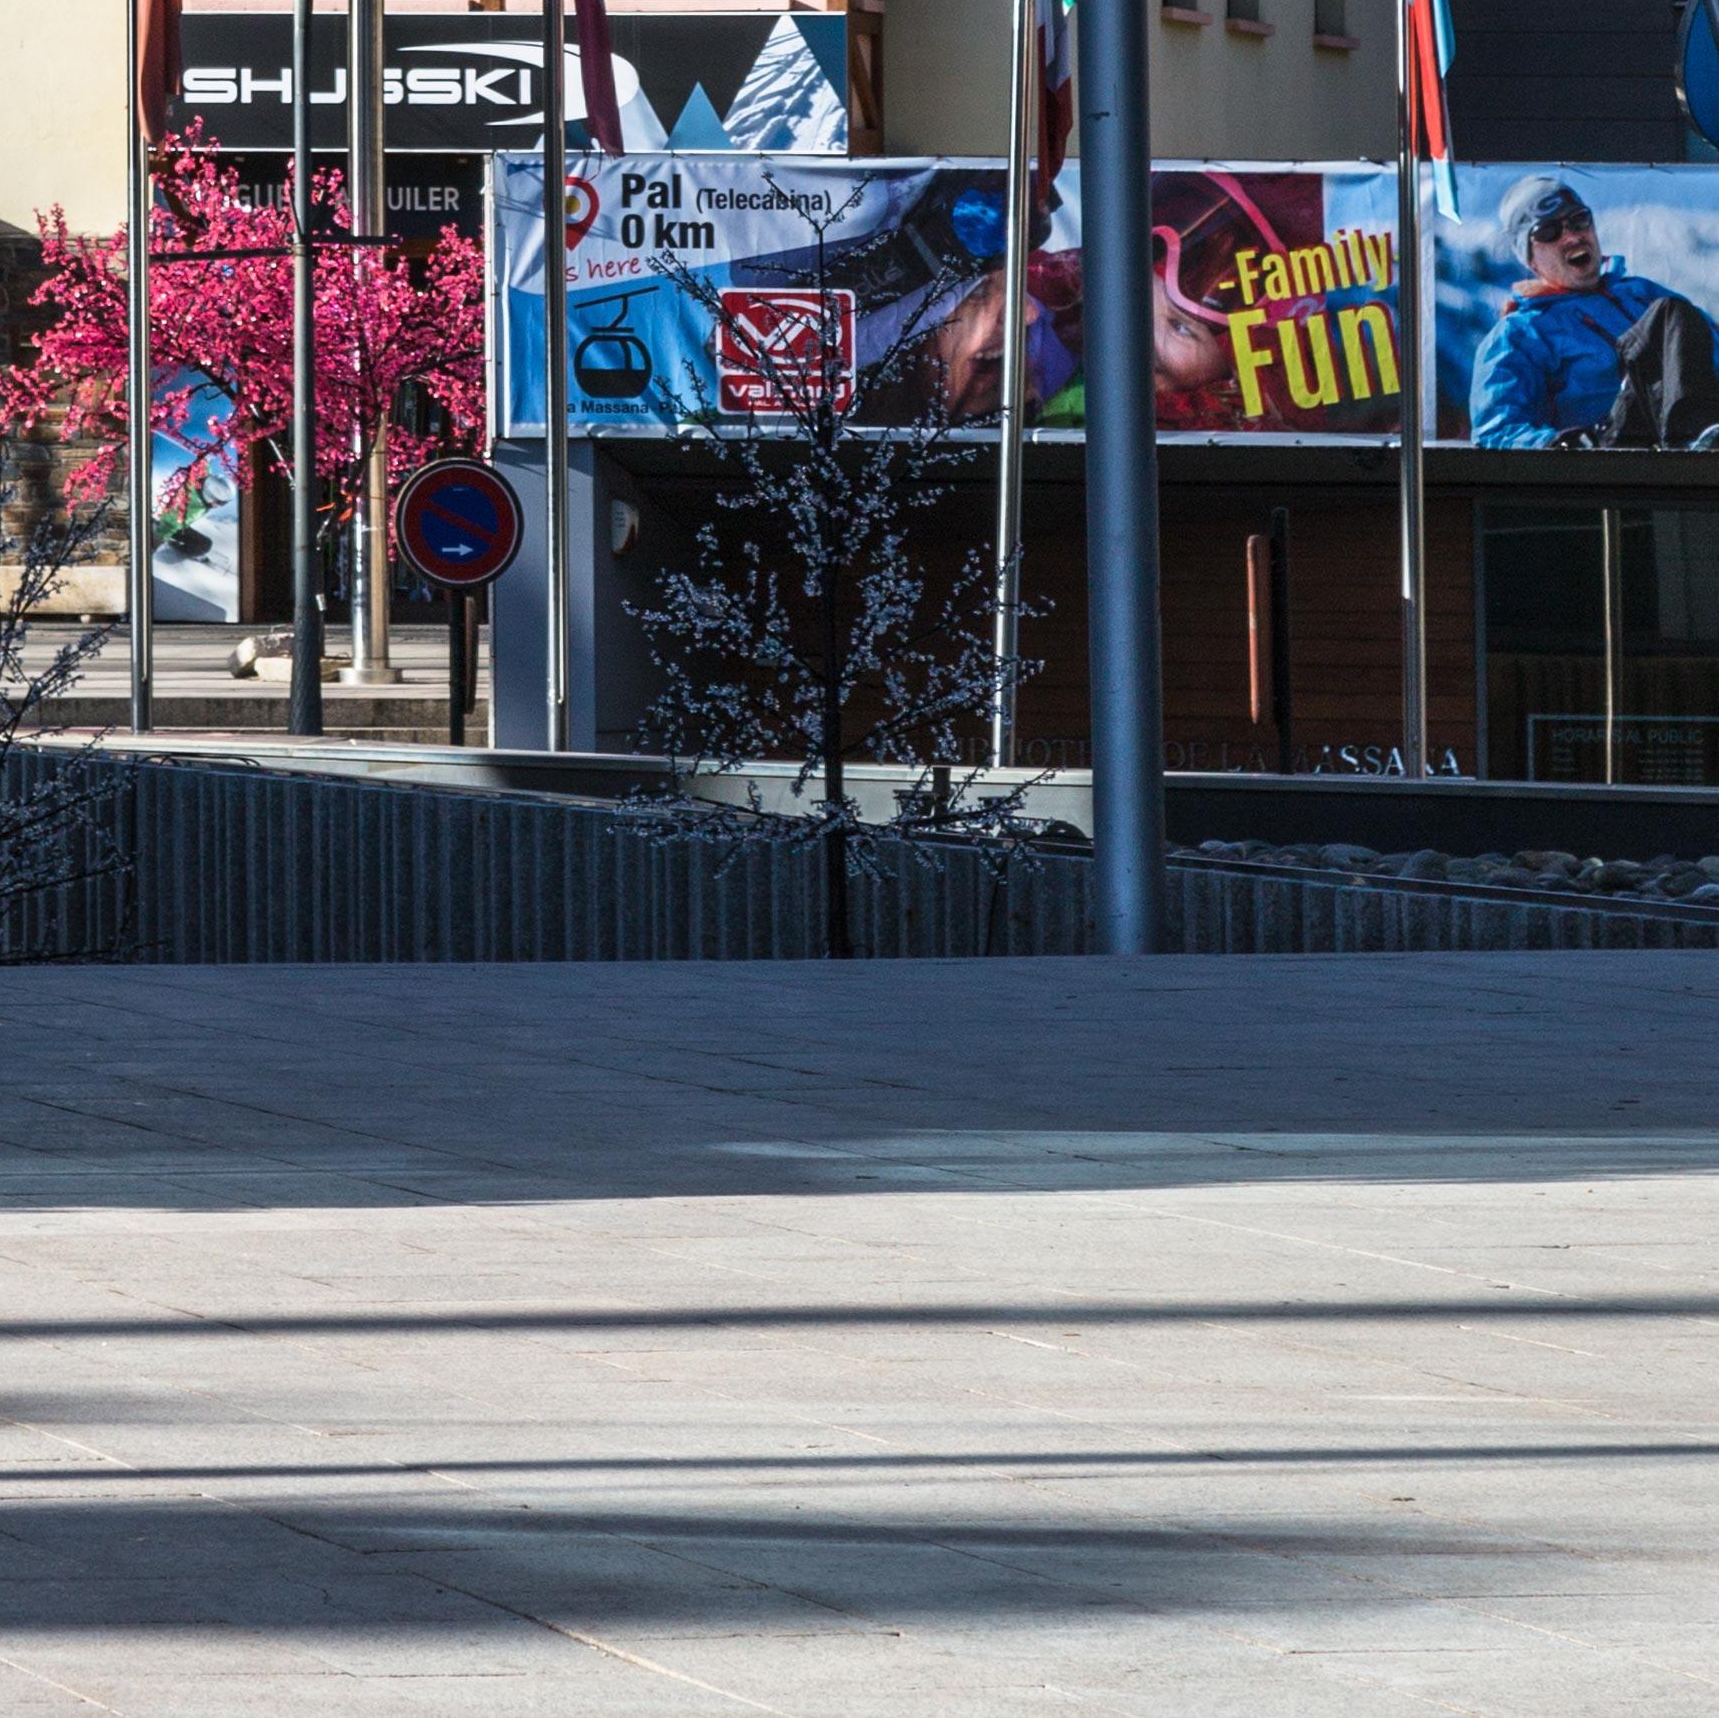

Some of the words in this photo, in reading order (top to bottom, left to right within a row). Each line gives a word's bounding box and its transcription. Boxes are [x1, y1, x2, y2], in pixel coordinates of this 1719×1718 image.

[621, 173, 682, 210] Pal
[696, 187, 832, 215] (Telecabina)
[621, 213, 646, 250] 0
[654, 212, 716, 250] km
[586, 257, 642, 280] here
[1225, 298, 1402, 419] Fun
[581, 400, 649, 414] Massana
